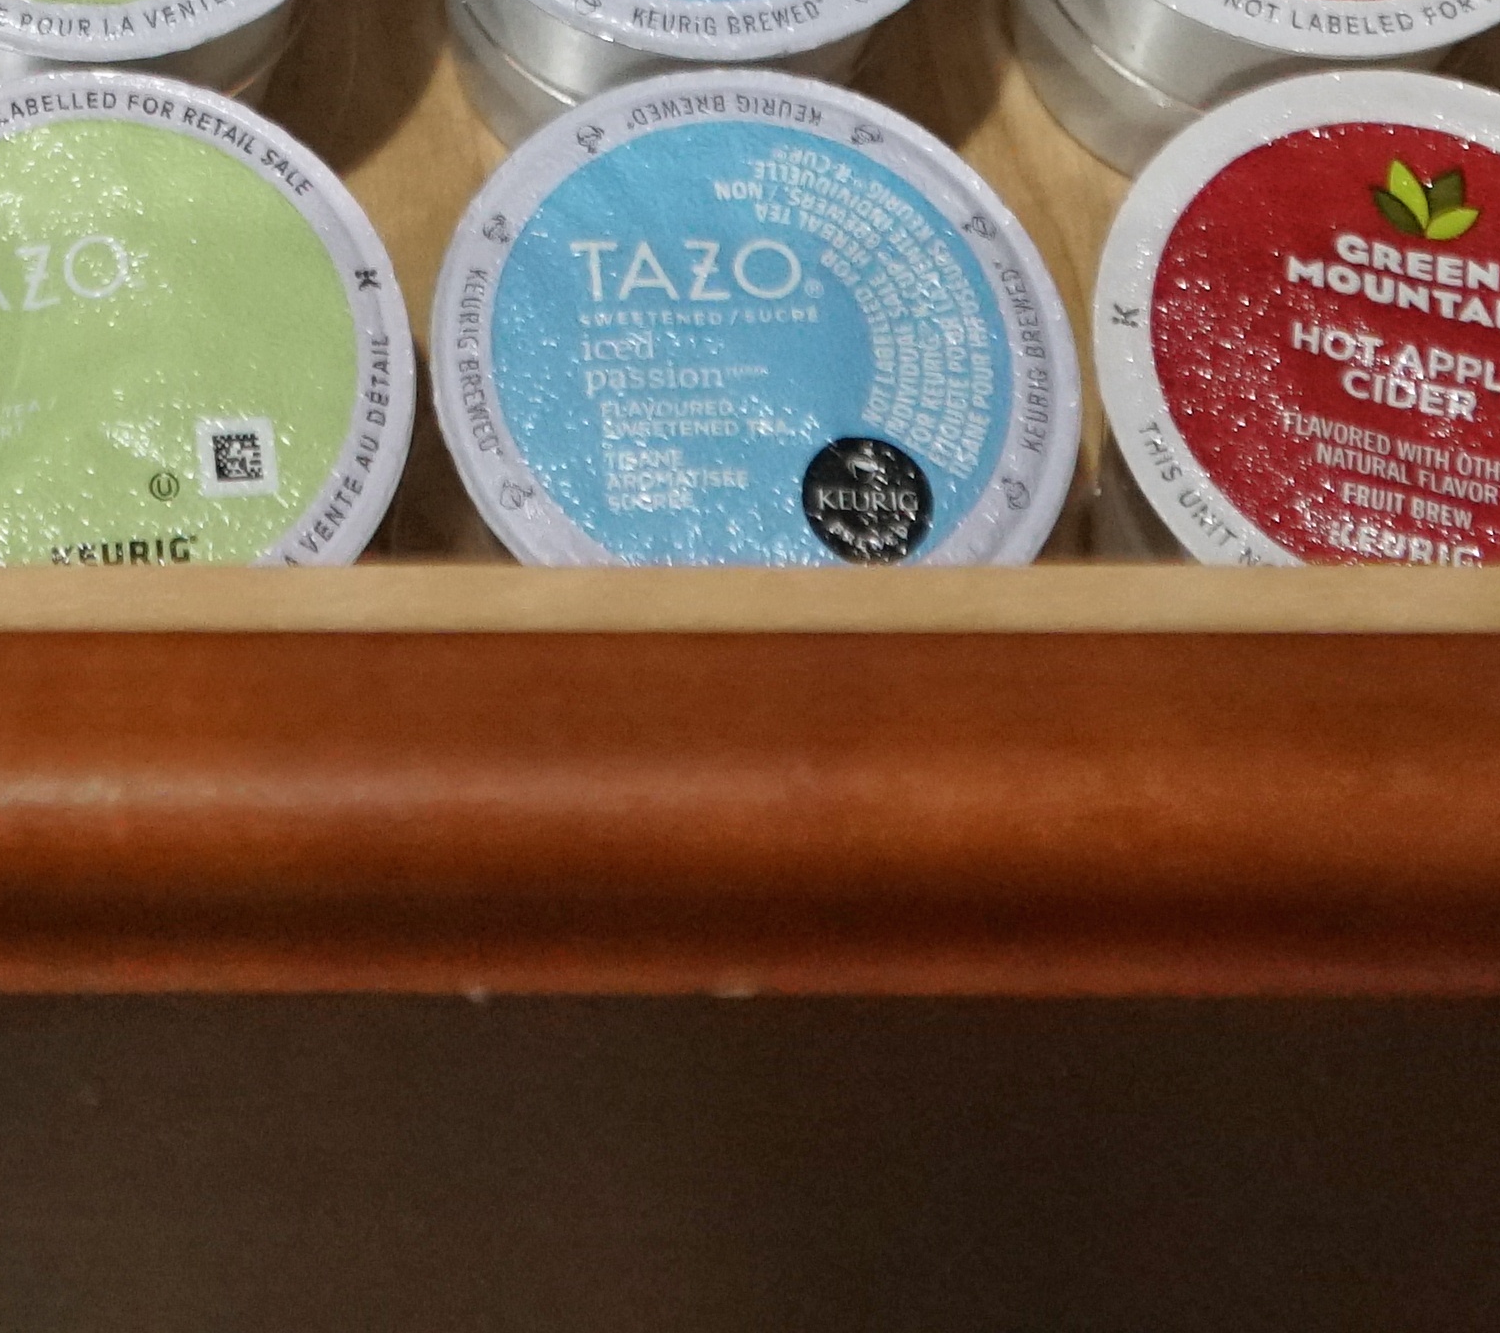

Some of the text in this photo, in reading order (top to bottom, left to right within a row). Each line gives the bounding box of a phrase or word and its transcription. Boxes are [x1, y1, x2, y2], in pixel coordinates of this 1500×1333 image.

[126, 92, 173, 118] FOR
[179, 103, 255, 158] RETAIL
[258, 144, 317, 200] SALE
[568, 236, 802, 301] TAZO
[1333, 231, 1500, 296] GREEN
[579, 329, 656, 366] iced
[1290, 323, 1383, 371] HOT
[583, 360, 729, 400] passion
[1339, 368, 1478, 423] CIDER
[1282, 410, 1377, 454] FLAVORED
[1380, 428, 1448, 469] WITH
